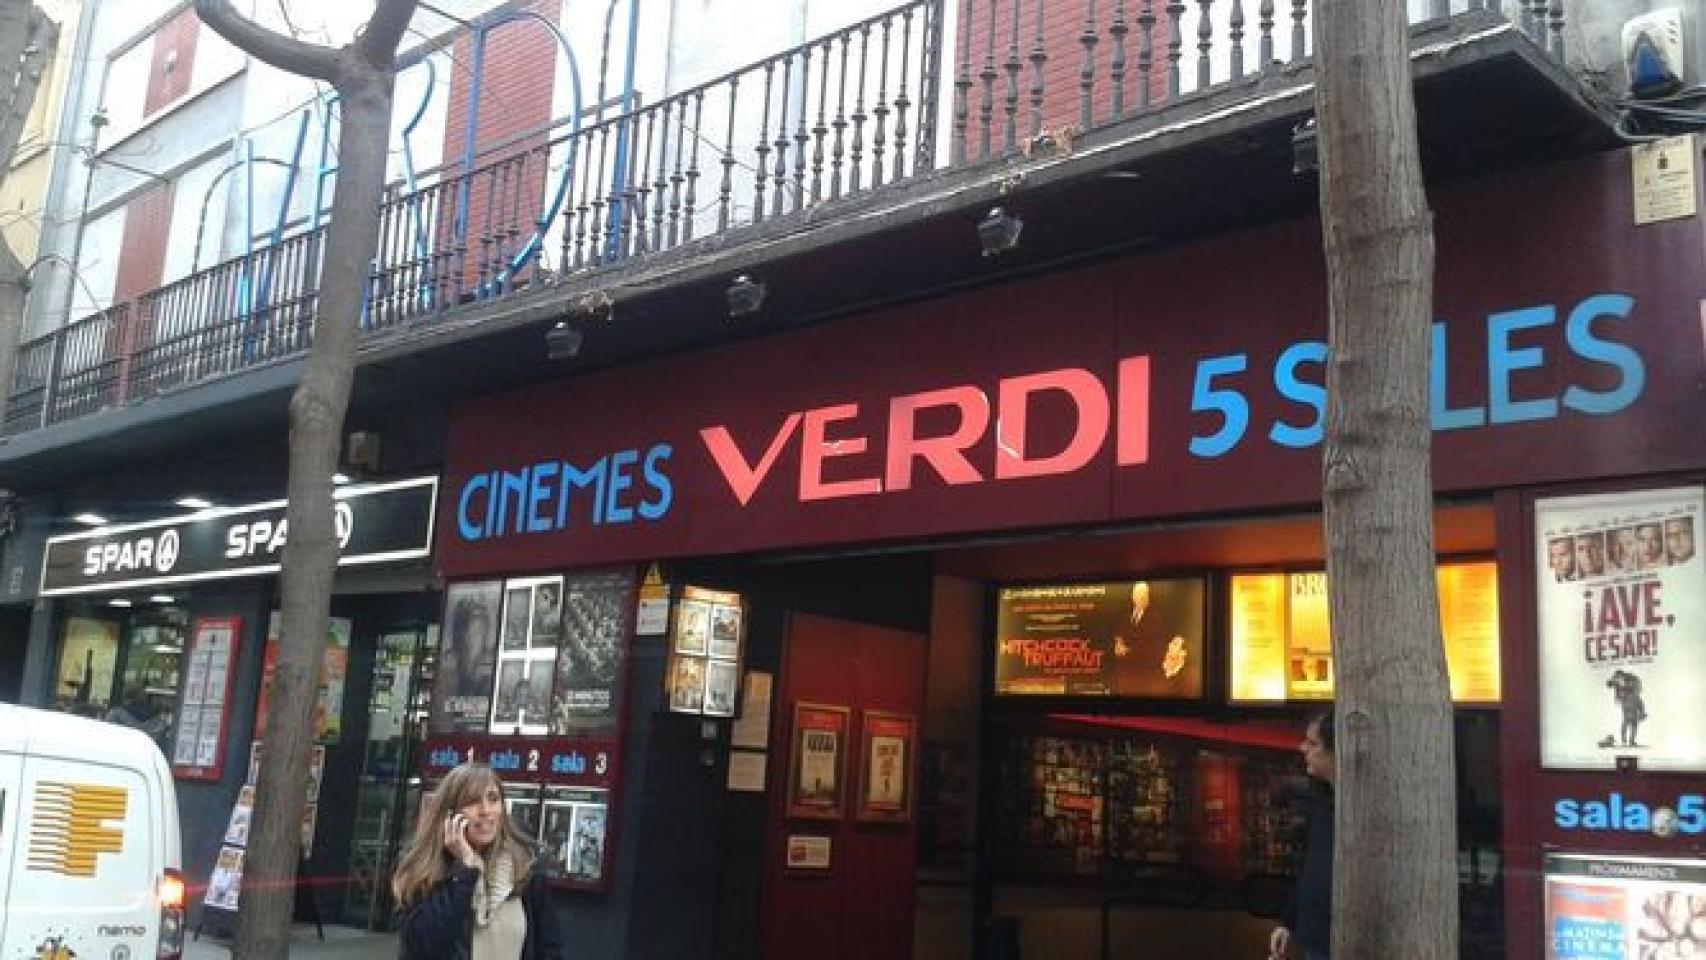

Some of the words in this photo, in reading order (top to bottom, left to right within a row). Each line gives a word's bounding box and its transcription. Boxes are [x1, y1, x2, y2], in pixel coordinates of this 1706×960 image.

[457, 443, 674, 541] CINEMES
[700, 354, 1150, 506] VERDI
[1188, 352, 1250, 459] 5
[1268, 292, 1646, 449] SLES
[84, 539, 152, 576] SPAR
[225, 519, 289, 559] SPA
[526, 749, 540, 772] 2
[595, 751, 607, 774] 3
[1554, 793, 1650, 831] sala
[1678, 794, 1706, 833] 5
